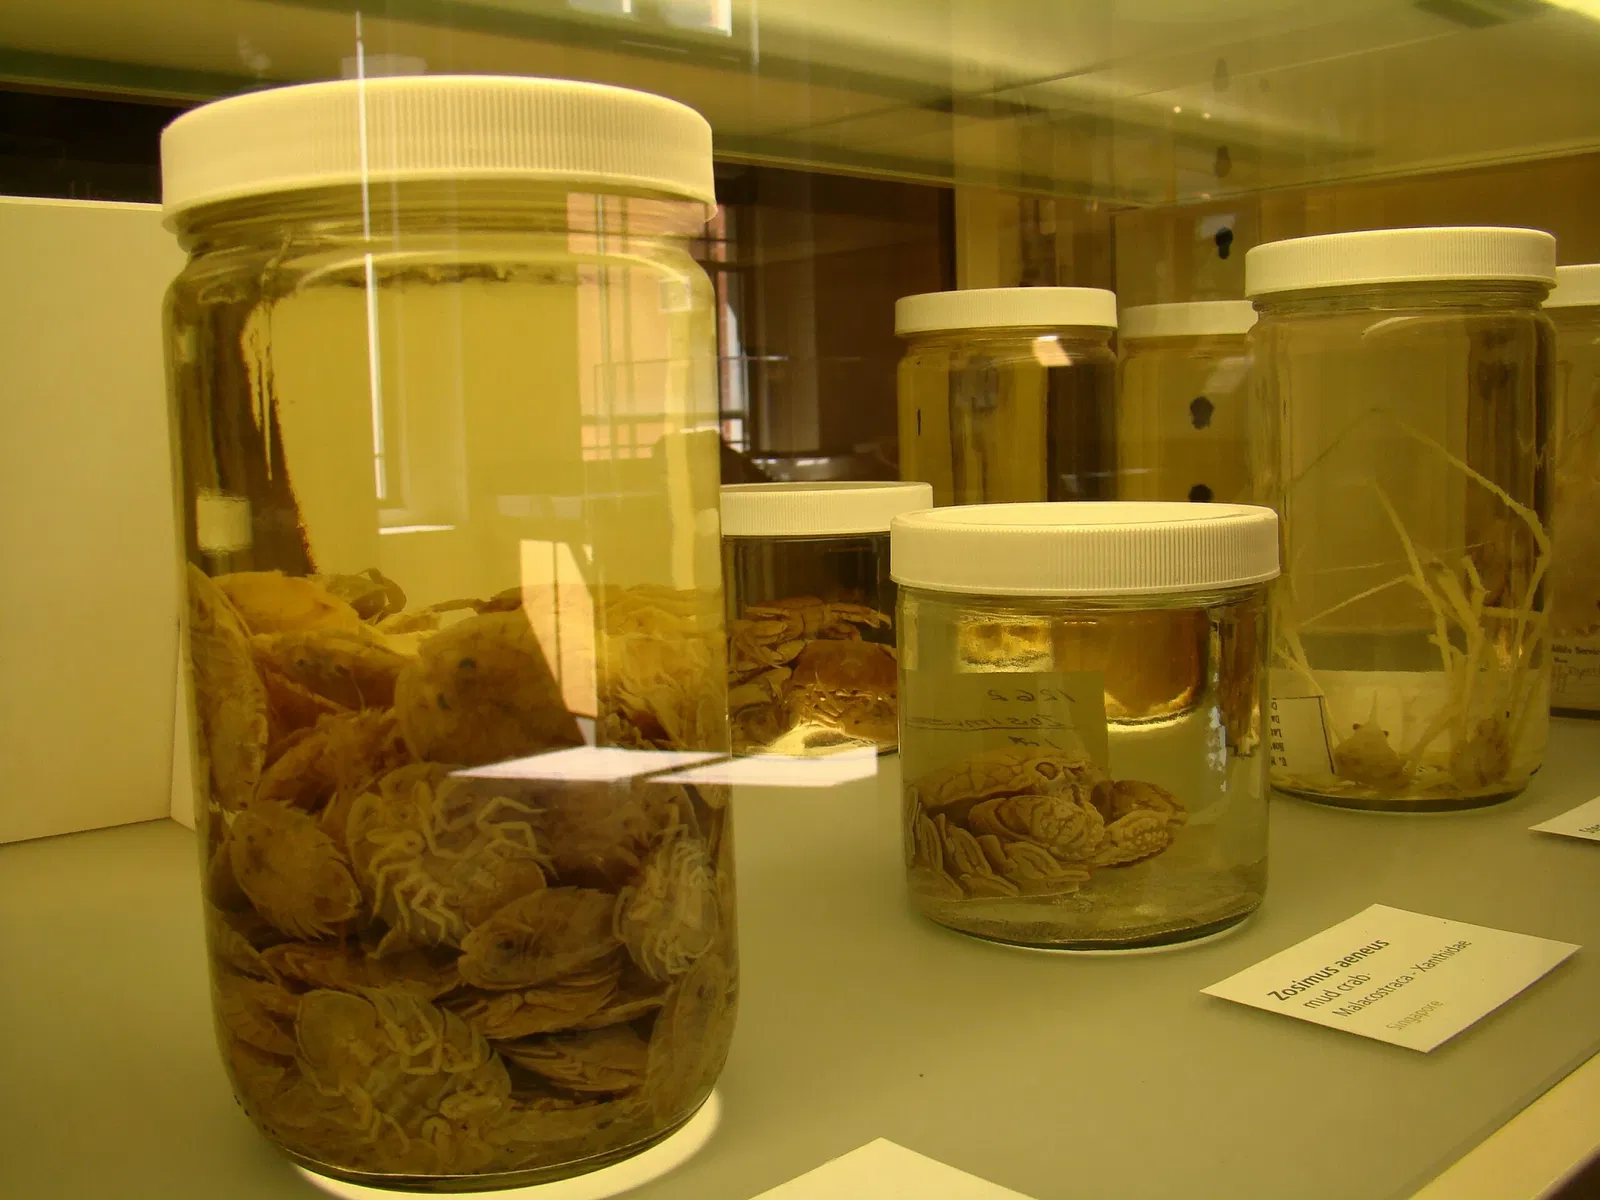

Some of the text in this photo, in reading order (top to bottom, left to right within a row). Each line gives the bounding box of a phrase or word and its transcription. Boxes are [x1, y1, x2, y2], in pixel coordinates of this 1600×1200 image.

[1266, 939, 1390, 1001] Zosimus aeneus
[1331, 974, 1414, 1017] Malacostraca
[1409, 940, 1472, 973] Xanthidae
[1303, 989, 1342, 1009] mud
[1385, 1000, 1444, 1031] Singapore
